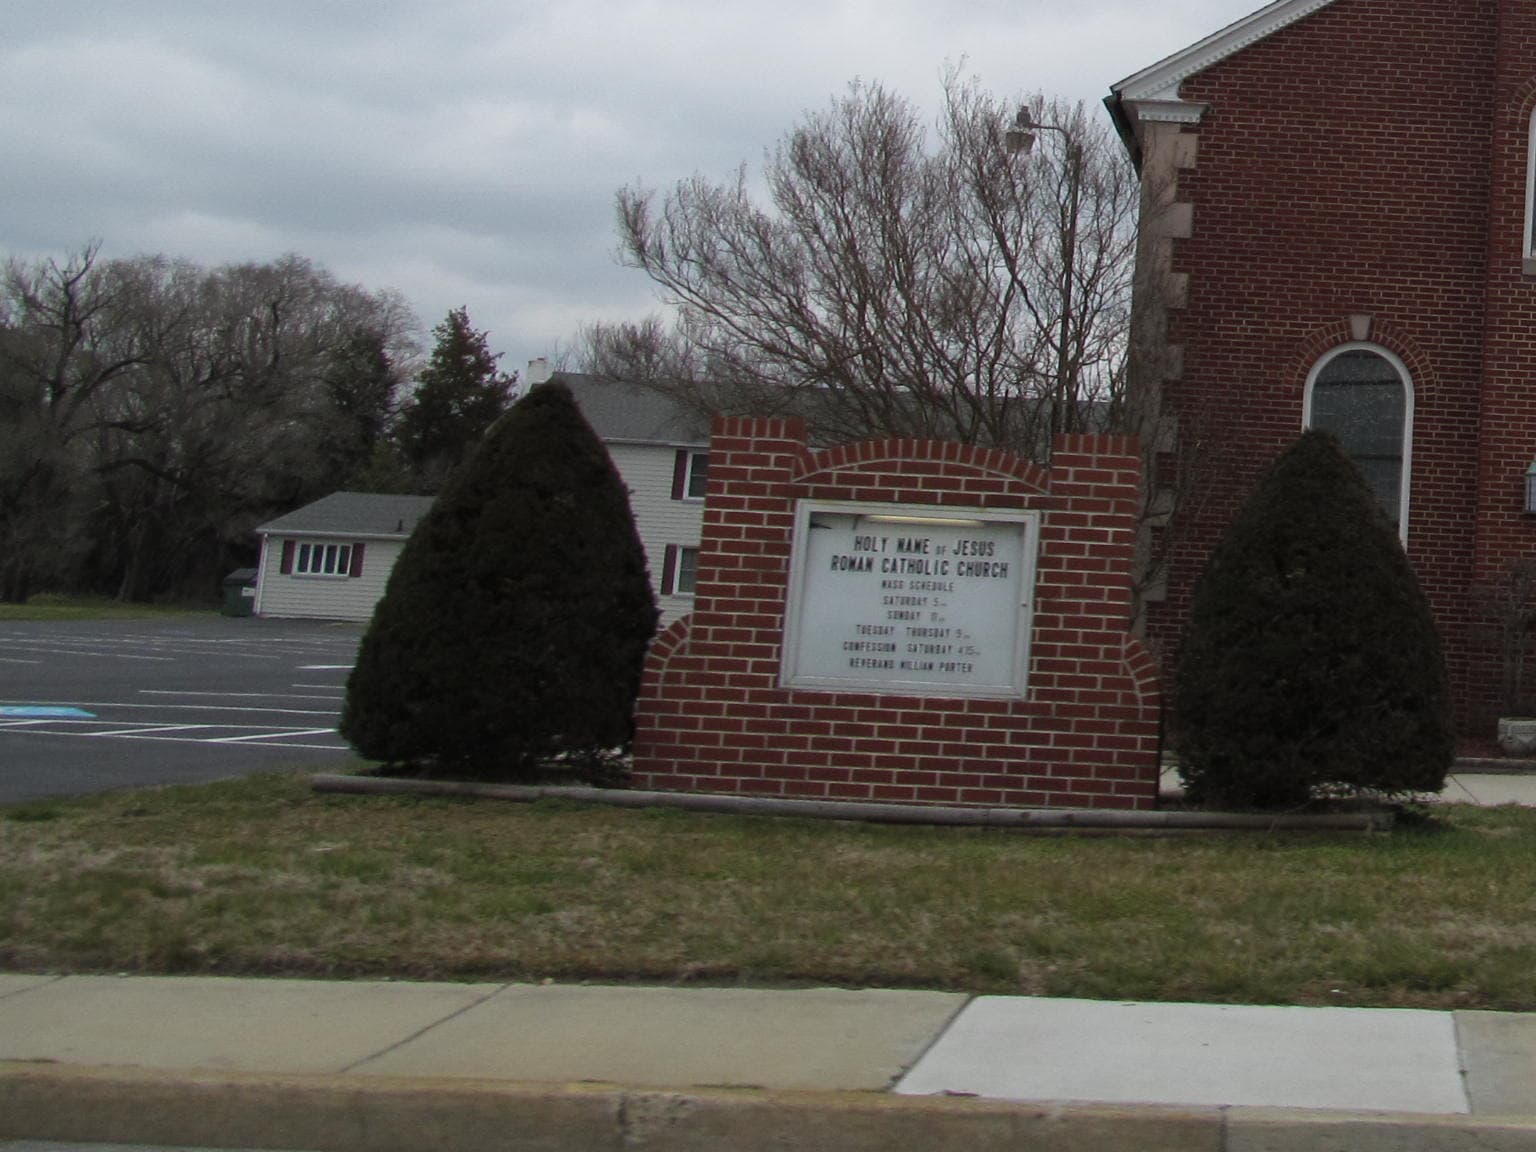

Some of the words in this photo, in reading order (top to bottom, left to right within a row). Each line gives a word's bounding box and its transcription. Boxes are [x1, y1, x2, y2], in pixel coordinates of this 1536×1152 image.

[854, 535, 888, 552] HOLY
[897, 537, 930, 554] NAME
[936, 545, 947, 555] OF
[953, 539, 995, 557] JESUS
[830, 555, 874, 572] ROMAN
[882, 558, 949, 575] CATHOLIC
[957, 560, 1009, 578] CHURCH
[882, 580, 904, 590] MASS
[909, 580, 954, 592] SCHEDULE
[883, 595, 928, 606] SATURDAY
[888, 610, 920, 620] SUNDAY
[856, 624, 895, 635] TUESDAY
[906, 627, 950, 638] THURSDAY
[843, 641, 896, 652] CONFESSION
[907, 643, 952, 654] SATURDAY
[901, 660, 934, 671] WILLIAM
